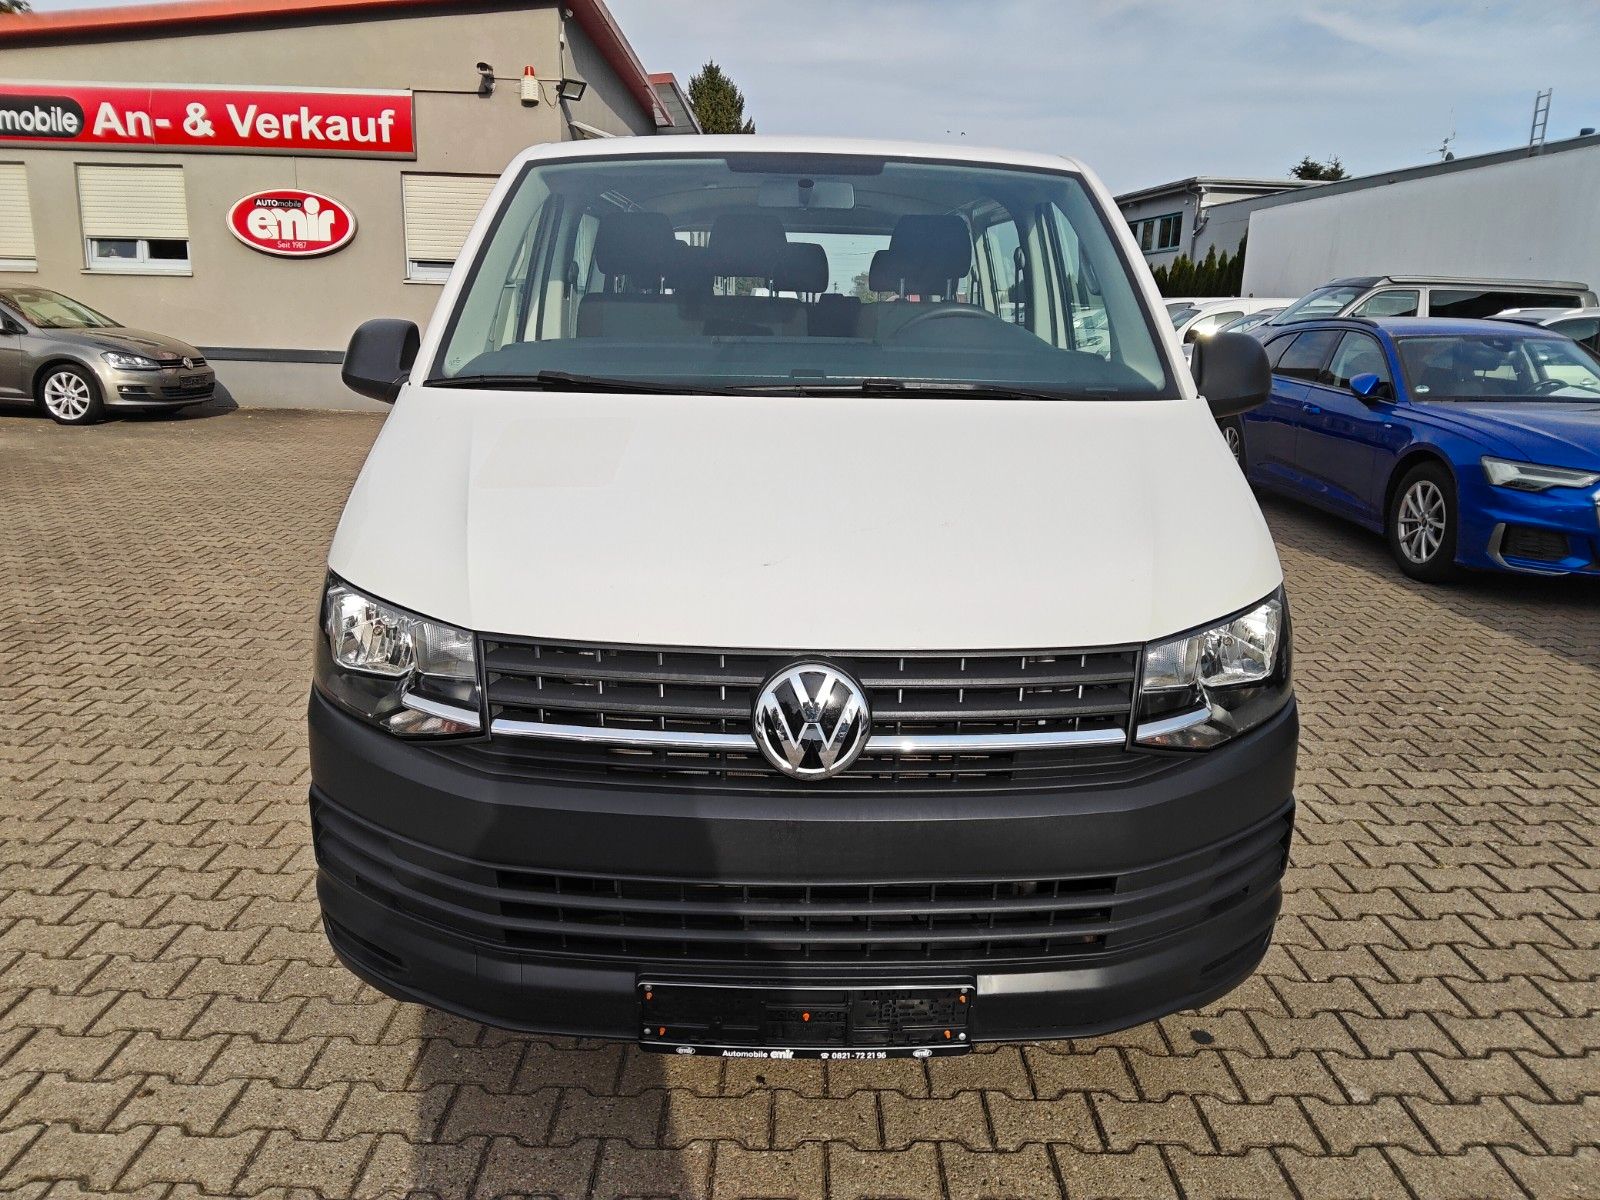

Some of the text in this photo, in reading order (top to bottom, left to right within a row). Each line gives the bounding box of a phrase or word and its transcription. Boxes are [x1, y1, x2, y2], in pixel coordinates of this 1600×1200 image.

[92, 102, 172, 138] An-
[183, 102, 217, 138] &
[226, 103, 395, 144] Verkauf
[255, 199, 302, 209] AUTOmobile
[247, 197, 336, 242] emir
[277, 241, 291, 249] Seit
[757, 663, 869, 778] VW
[722, 1048, 794, 1060] Automobile emir
[831, 1051, 850, 1060] 0821
[856, 1051, 866, 1060] 72
[867, 1051, 876, 1060] 21
